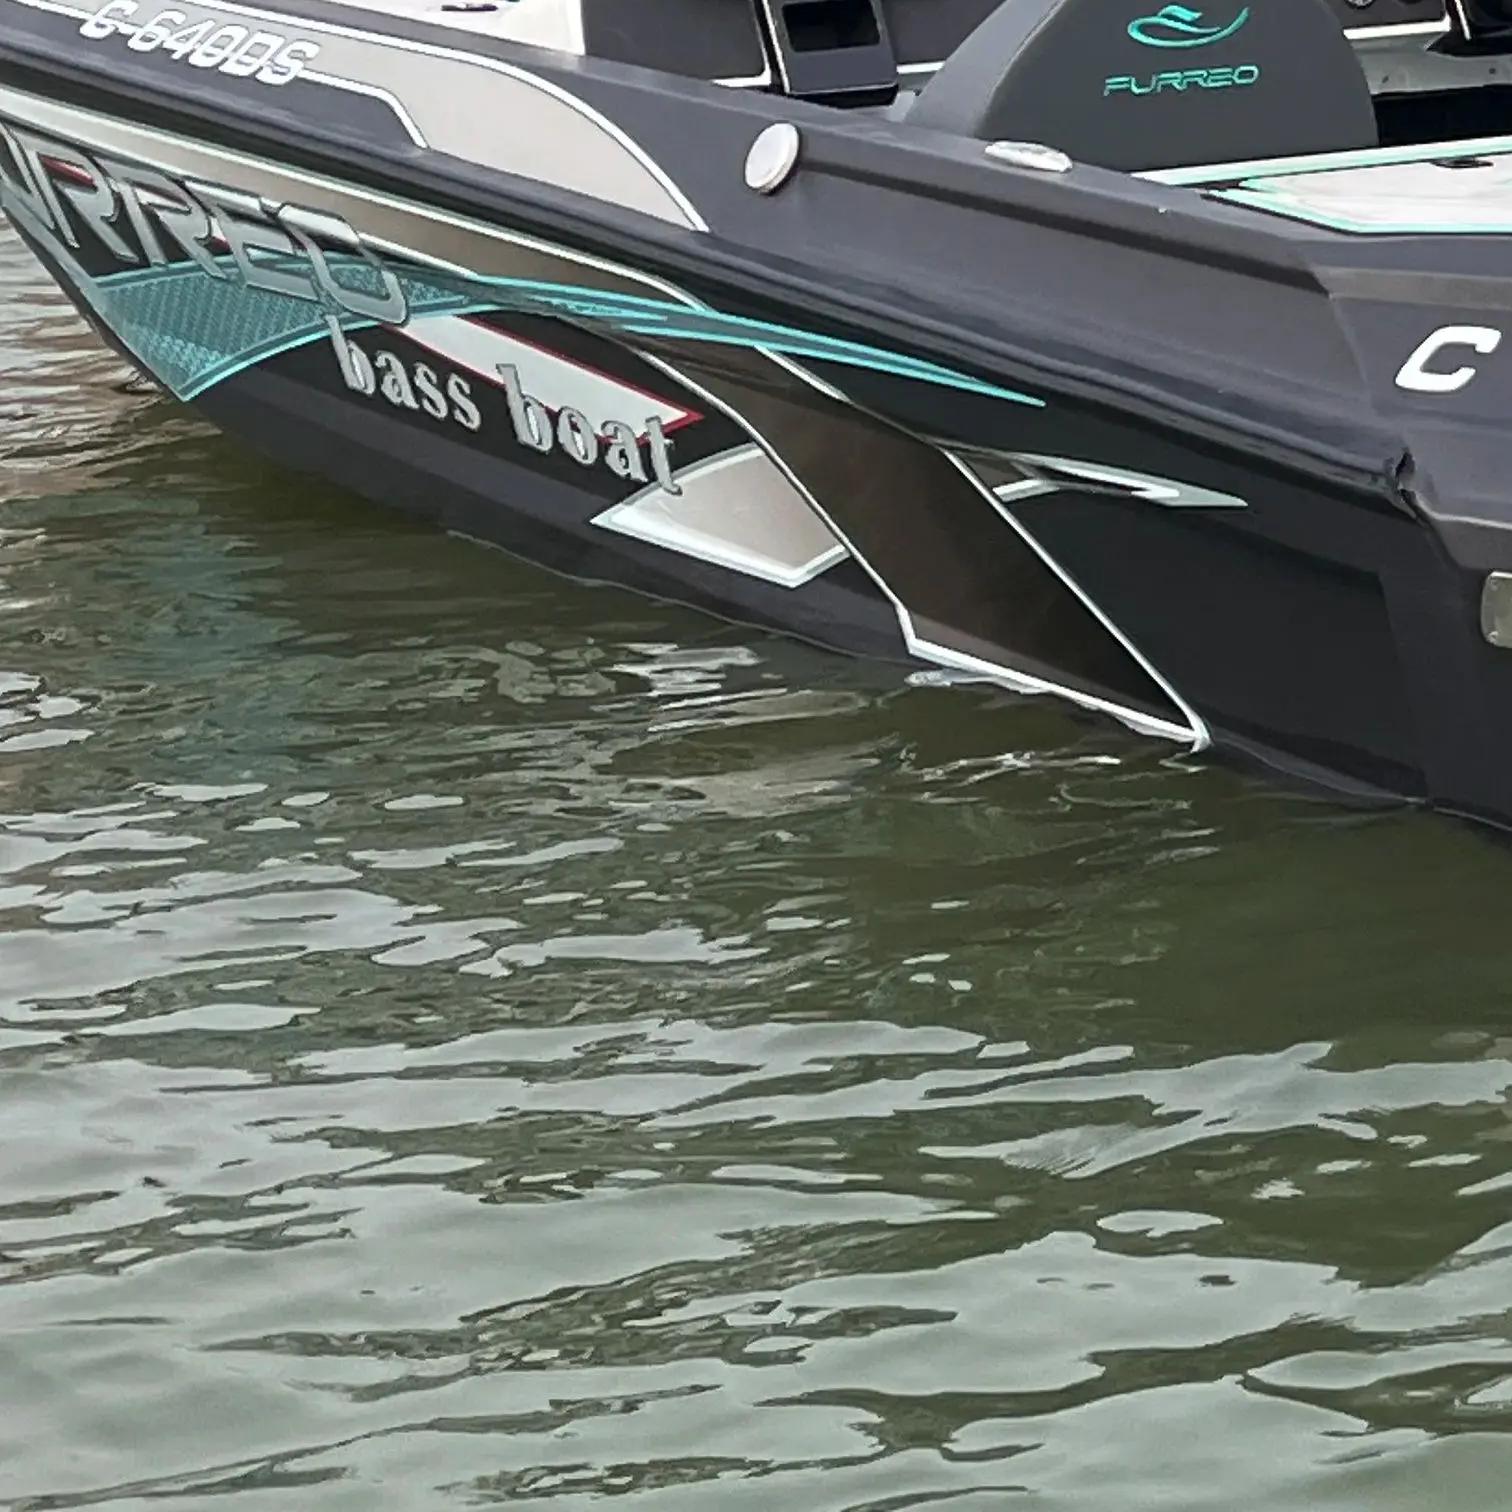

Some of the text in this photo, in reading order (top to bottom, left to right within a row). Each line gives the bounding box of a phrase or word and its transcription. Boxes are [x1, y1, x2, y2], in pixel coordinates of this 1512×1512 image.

[1103, 64, 1260, 98] FURREO
[1394, 324, 1502, 394] C
[325, 314, 684, 496] bass boat
